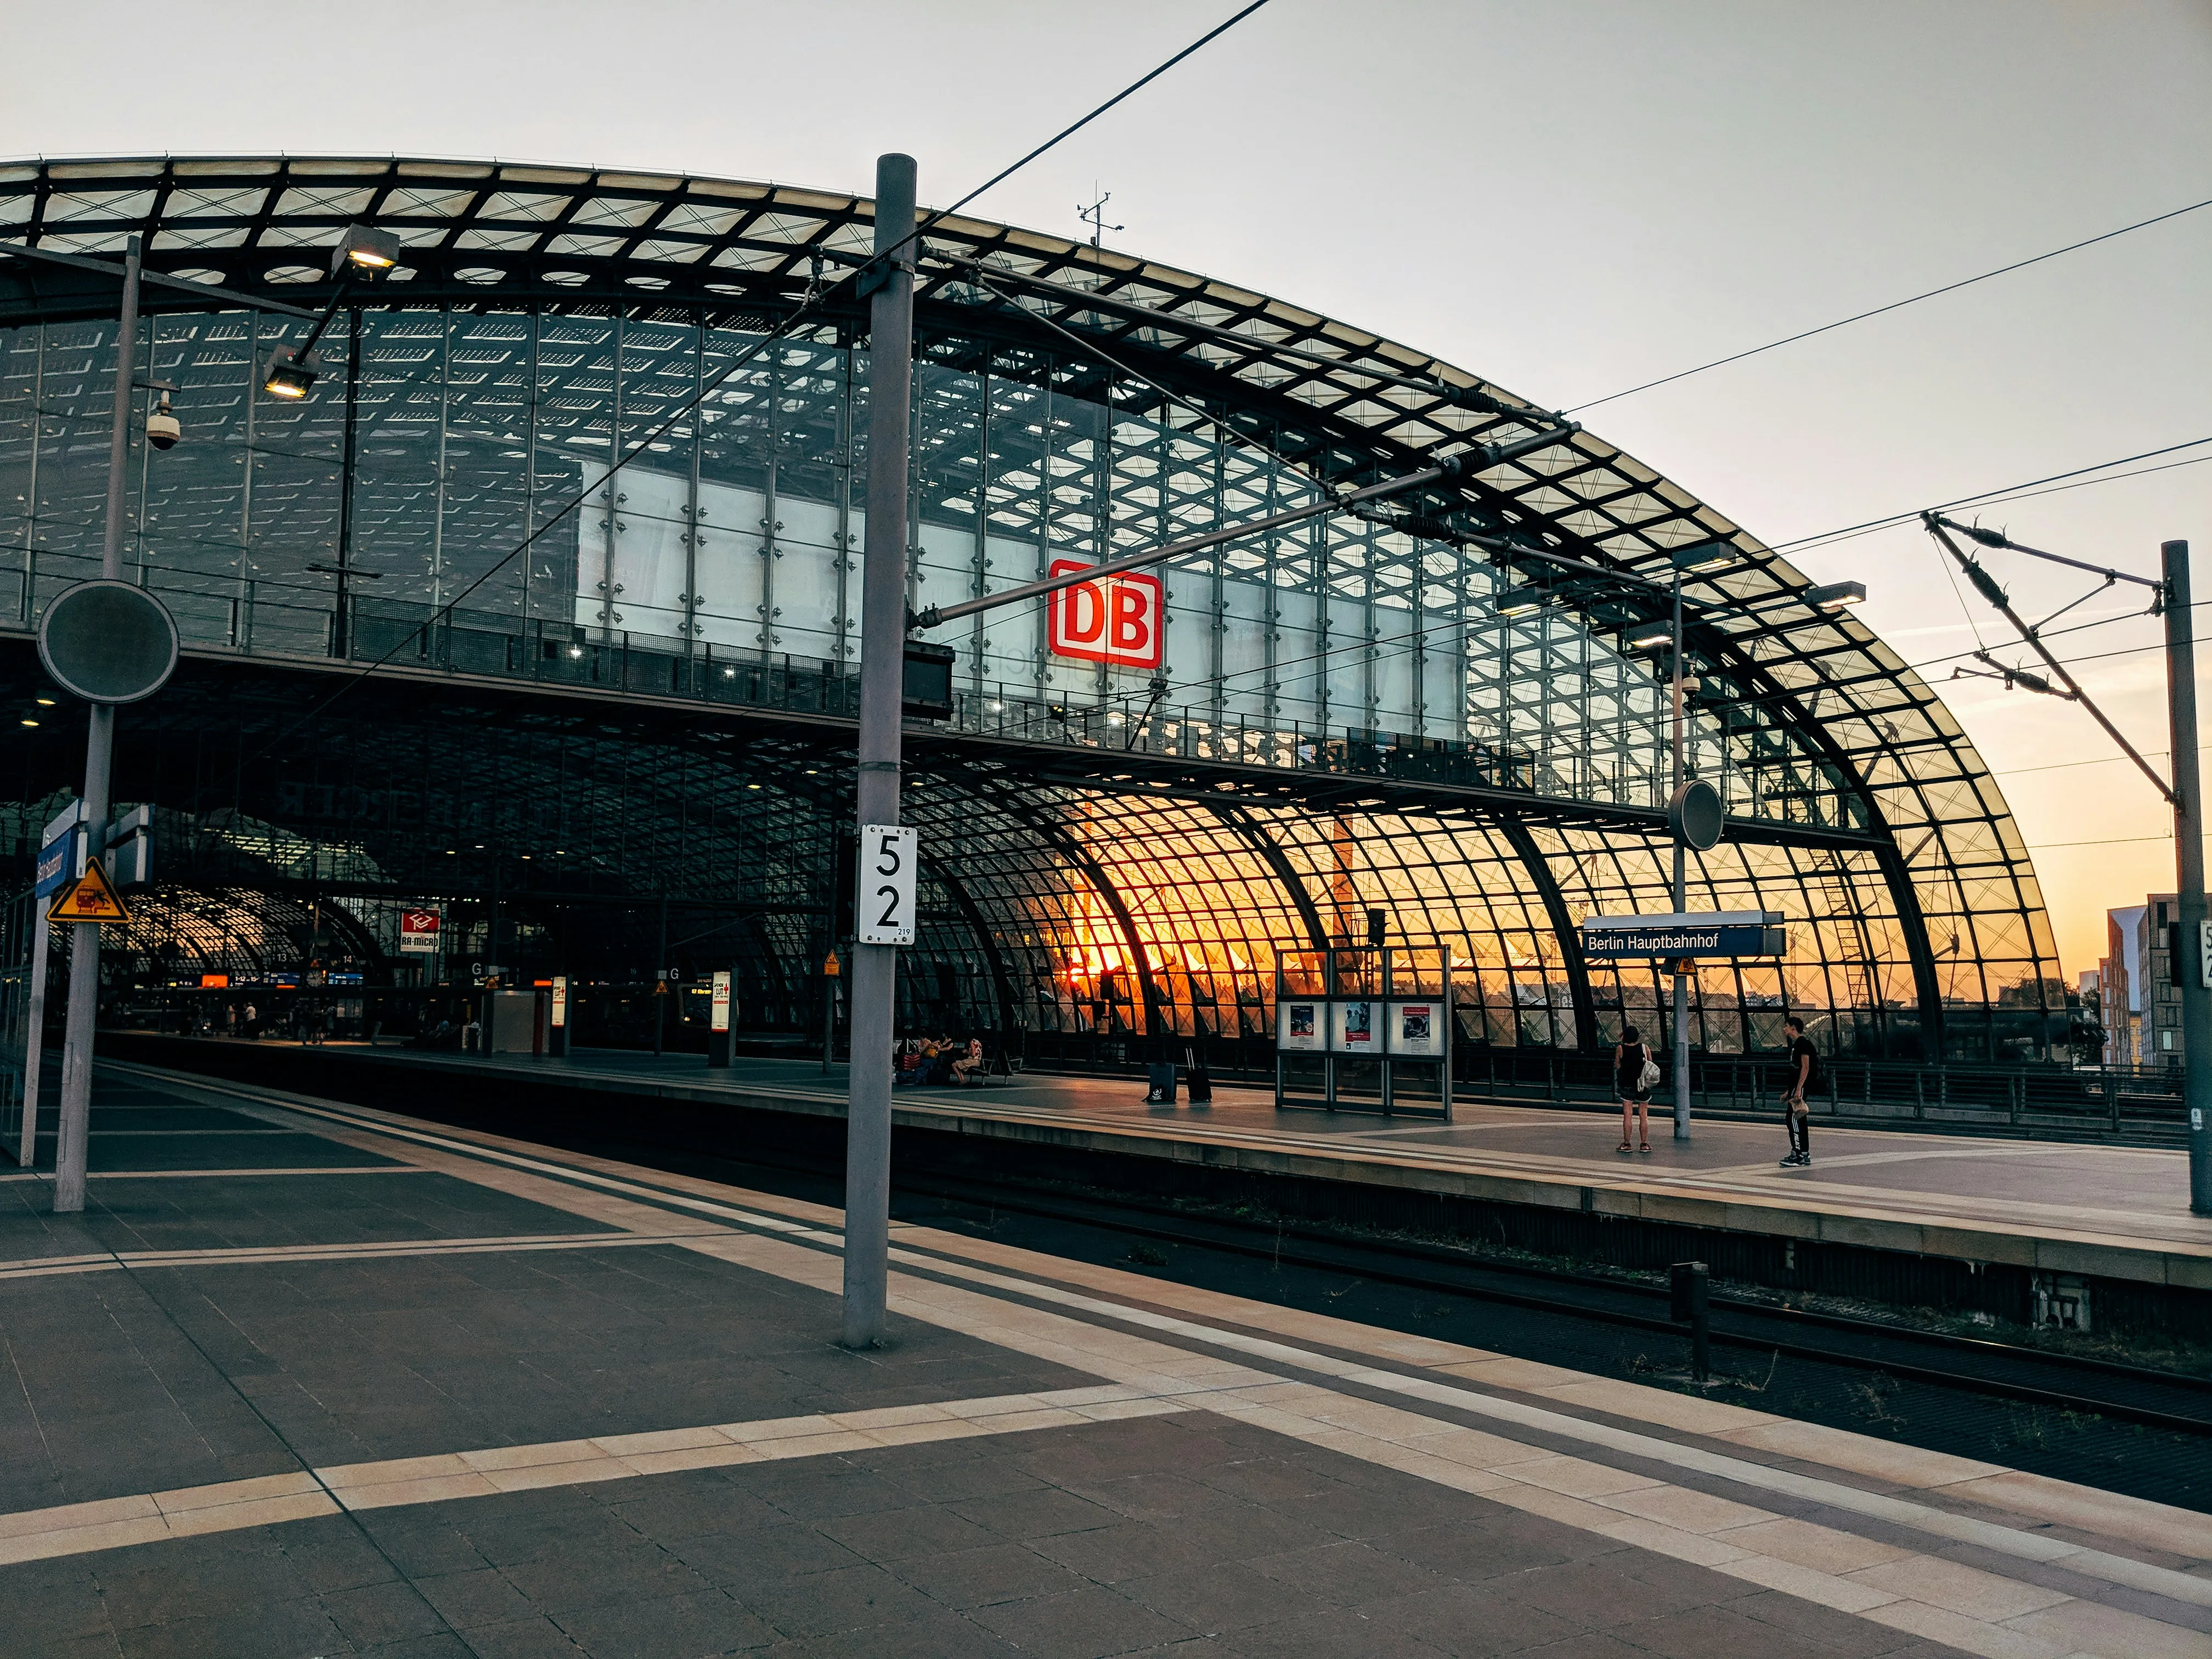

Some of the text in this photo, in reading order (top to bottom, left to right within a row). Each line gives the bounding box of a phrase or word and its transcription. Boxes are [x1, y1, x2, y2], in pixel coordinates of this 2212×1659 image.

[1064, 579, 1149, 650] DB
[876, 834, 900, 877] 5
[876, 884, 900, 927] 2
[1588, 933, 1719, 952] Berlin Hauptbahnhof
[277, 953, 287, 962] 13
[343, 955, 352, 963] 14
[472, 963, 482, 975] G
[670, 968, 679, 979] G
